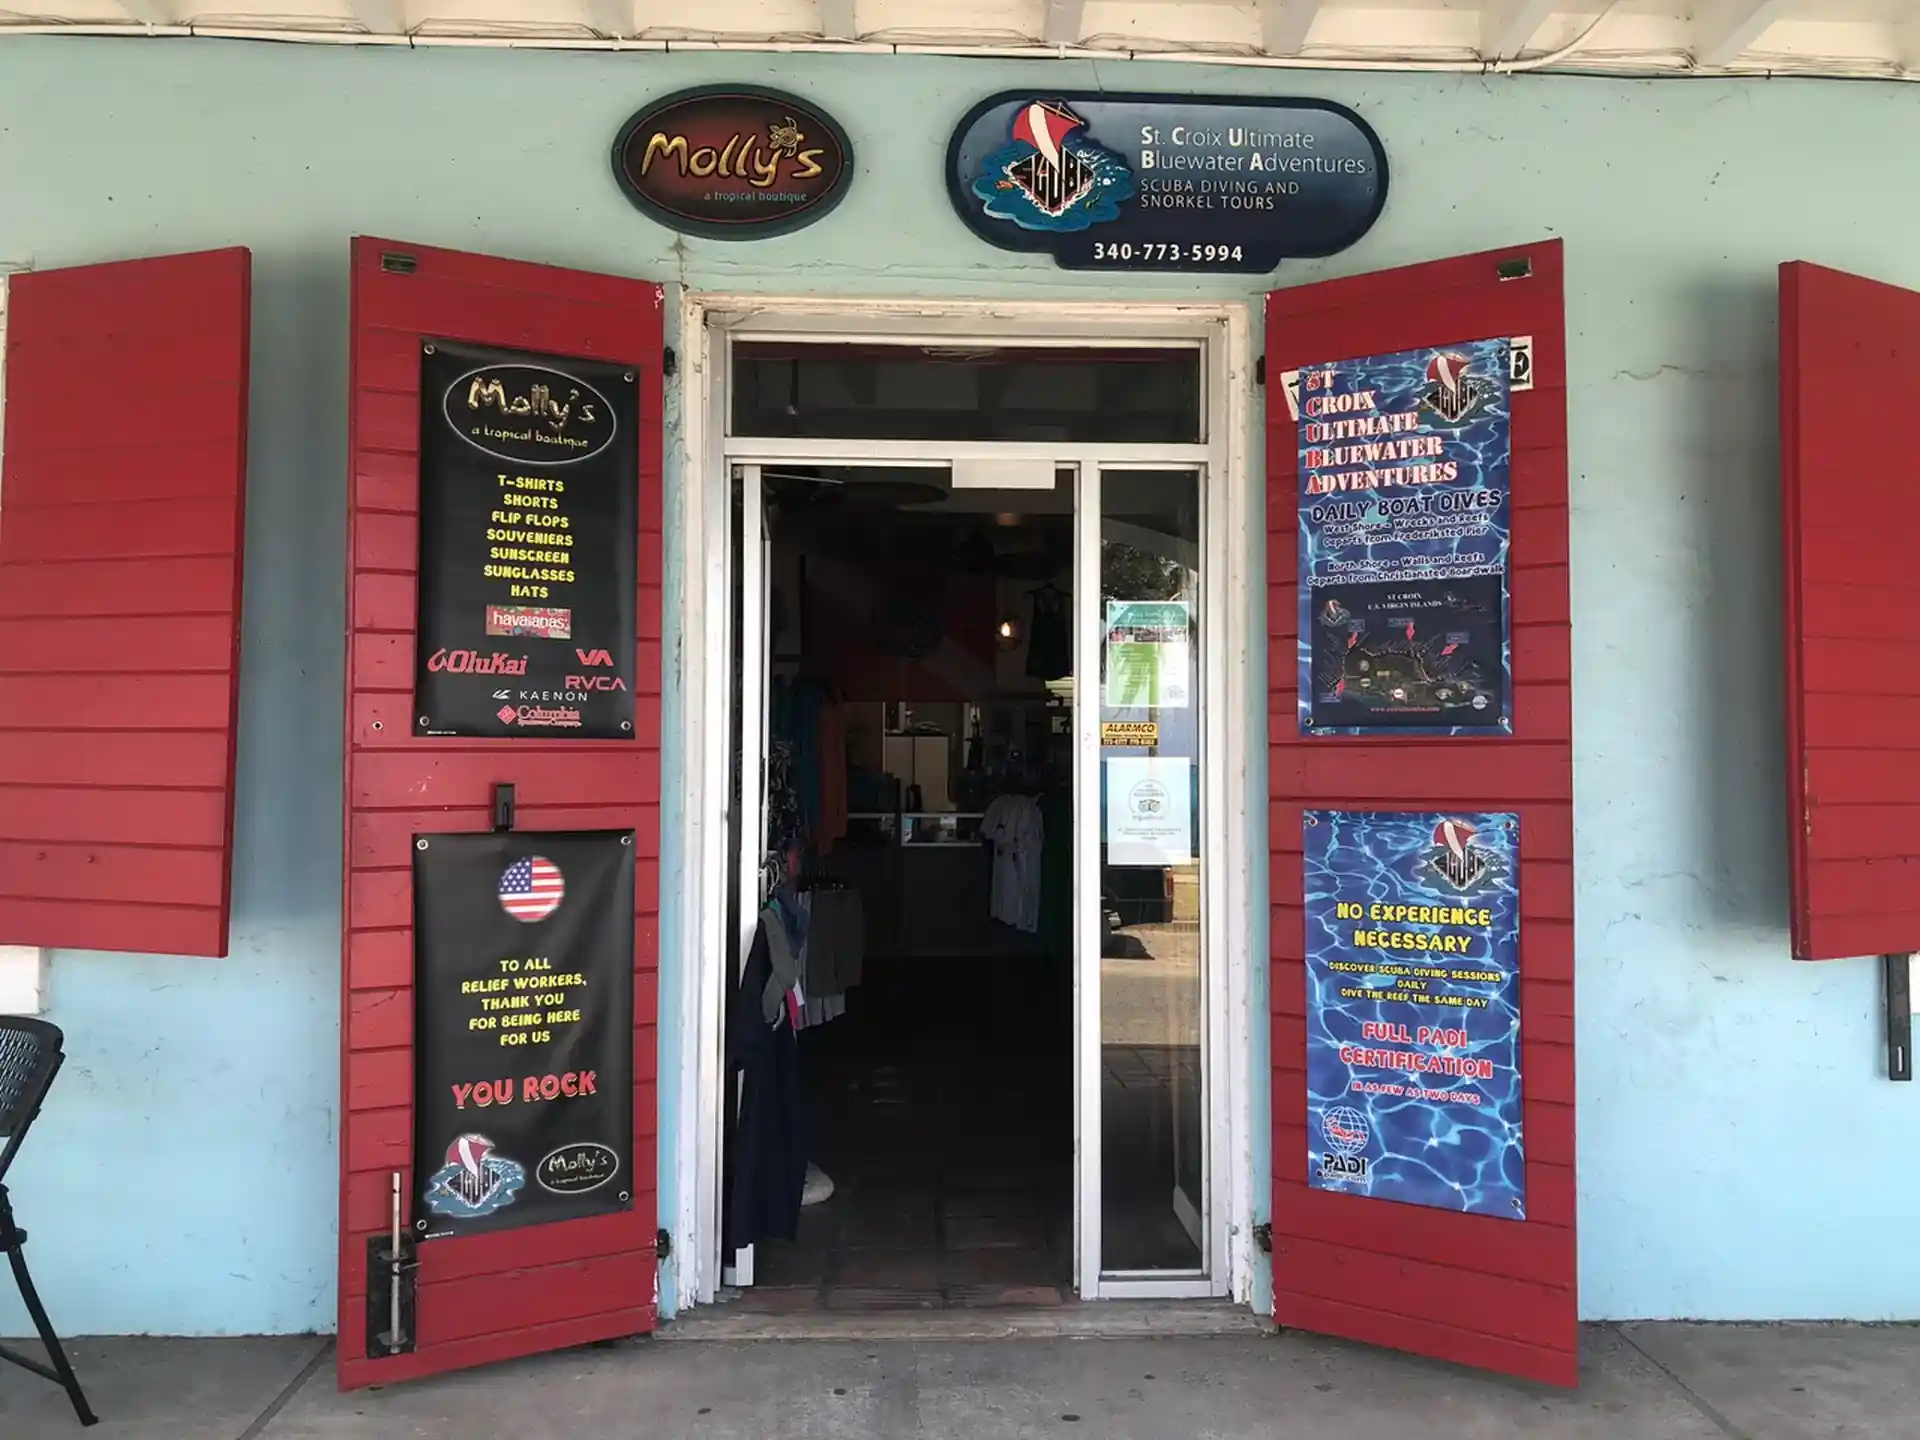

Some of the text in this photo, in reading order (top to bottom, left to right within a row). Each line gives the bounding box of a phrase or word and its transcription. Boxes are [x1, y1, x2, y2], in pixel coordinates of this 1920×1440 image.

[1140, 127, 1314, 149] St. Croix Ultimate
[641, 132, 824, 187] Molly's
[1140, 150, 1366, 174] Bluewater Adventures
[704, 191, 807, 203] a tropical boutique
[1140, 179, 1299, 195] SCUBA DIVING AND
[1140, 194, 1275, 210] SNORKEL TOURS
[1093, 243, 1244, 262] 340-773-5994
[1306, 370, 1336, 391] ST
[467, 376, 597, 430] Molly's
[1306, 391, 1376, 417] CROIX
[472, 427, 480, 435] a
[484, 425, 532, 443] tropical
[1305, 411, 1420, 443] ULTIMATE
[1305, 436, 1444, 469] BLUEWATER
[497, 474, 564, 492] T-SHIRTS
[1305, 461, 1458, 495] ADVENTURES
[503, 493, 558, 509] SHORTS
[1311, 488, 1502, 523] DAILY BOAT DIVES
[491, 511, 569, 528] FLIP FLOPS
[1323, 522, 1350, 535] West
[1352, 520, 1381, 533] Shore
[1393, 517, 1437, 530] Wrecks
[1437, 514, 1456, 527] and
[1458, 512, 1489, 525] Reefs
[486, 529, 574, 546] SOUVENIERS
[1323, 525, 1488, 549] Departs from Frederiksted Pier
[490, 547, 569, 564] SUNSCREEN
[1327, 560, 1357, 573] North
[1359, 558, 1390, 571] Shore
[1401, 555, 1430, 568] Walls
[1432, 553, 1452, 566] and
[1454, 551, 1485, 564] Reefs
[483, 564, 575, 582] SUNGLASSES
[1307, 563, 1505, 588] Departs from Christiansted Boardwalk
[511, 584, 549, 598] HATS
[493, 610, 565, 630] havaianas
[448, 650, 529, 676] OluKai
[565, 675, 627, 691] RVCA
[519, 690, 588, 702] KAENON
[517, 705, 581, 721] Columbia
[1106, 723, 1155, 733] ALARMCO
[1336, 902, 1491, 926] NO EXPERIENCE
[1354, 930, 1472, 953] NECESSARY
[500, 958, 551, 972] TO ALL
[1328, 961, 1501, 982] DISCOVER SCUBA DIVING SESSIONS
[461, 973, 587, 994] RELIEF WORKERS,
[1397, 980, 1427, 990] DAILY
[481, 992, 564, 1011] THANK YOU
[1366, 989, 1383, 999] THE
[1387, 990, 1409, 1001] REEF
[1413, 993, 1430, 1003] THE
[1434, 994, 1464, 1005] SAME
[1466, 997, 1489, 1008] DAY
[469, 1009, 581, 1031] FOR BEING HERE
[500, 1031, 551, 1046] FOR US
[1362, 1021, 1467, 1048] FULL PADI
[1339, 1047, 1493, 1079] CERTIFICATION
[451, 1070, 597, 1109] YOU ROCK
[1351, 1082, 1481, 1105] IN AS FEW AS TWO DAYS
[548, 1150, 608, 1176] Molly's
[1323, 1153, 1366, 1176] PADI
